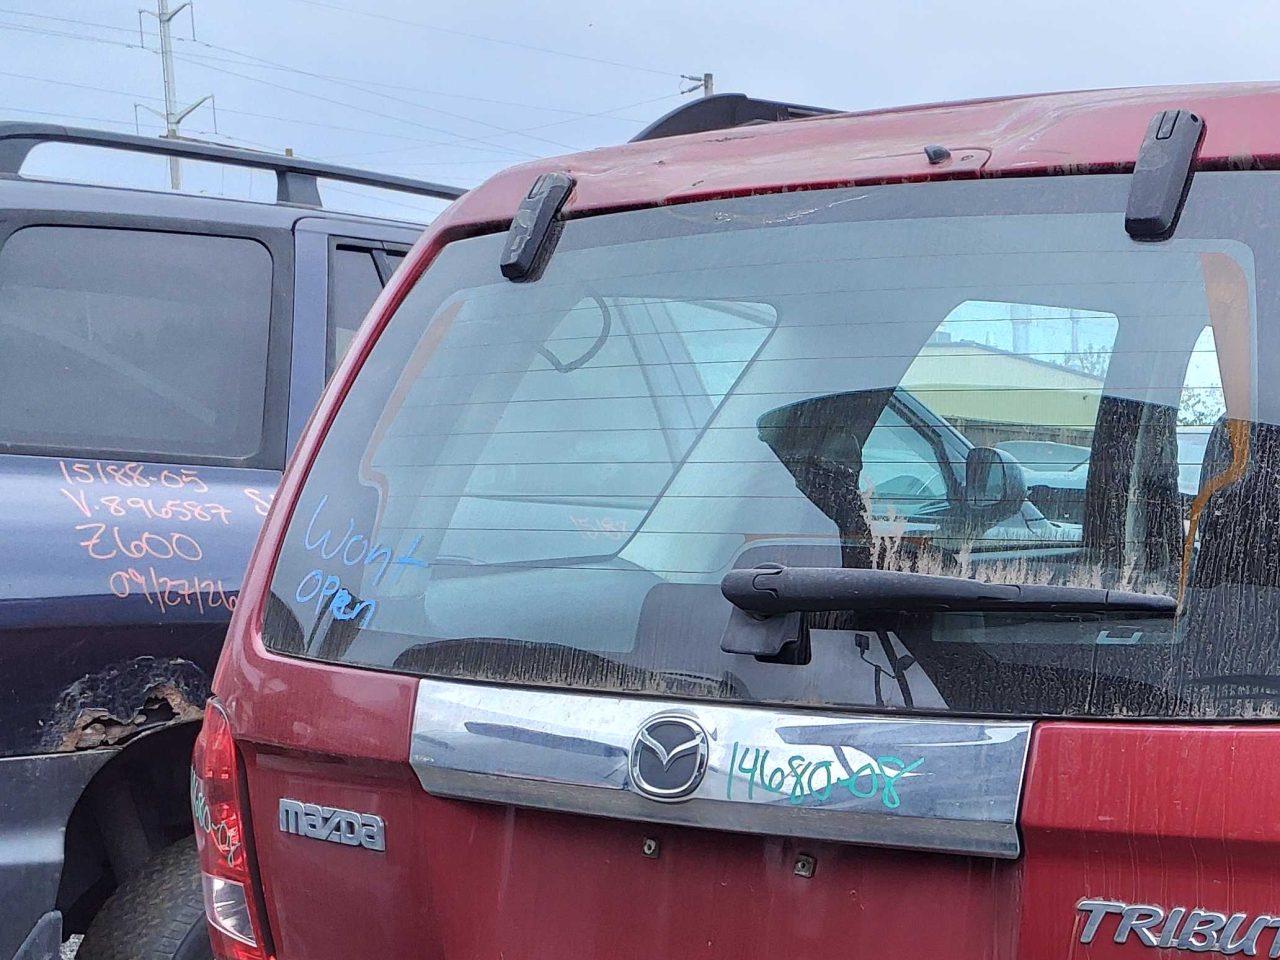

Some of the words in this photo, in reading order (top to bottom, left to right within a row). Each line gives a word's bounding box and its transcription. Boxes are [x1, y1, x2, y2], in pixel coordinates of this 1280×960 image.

[58, 460, 209, 493] 15188-05
[59, 487, 233, 525] V.896587
[74, 523, 203, 561] Z600
[109, 566, 239, 614] 09/27/26
[727, 741, 926, 809] 14680-08
